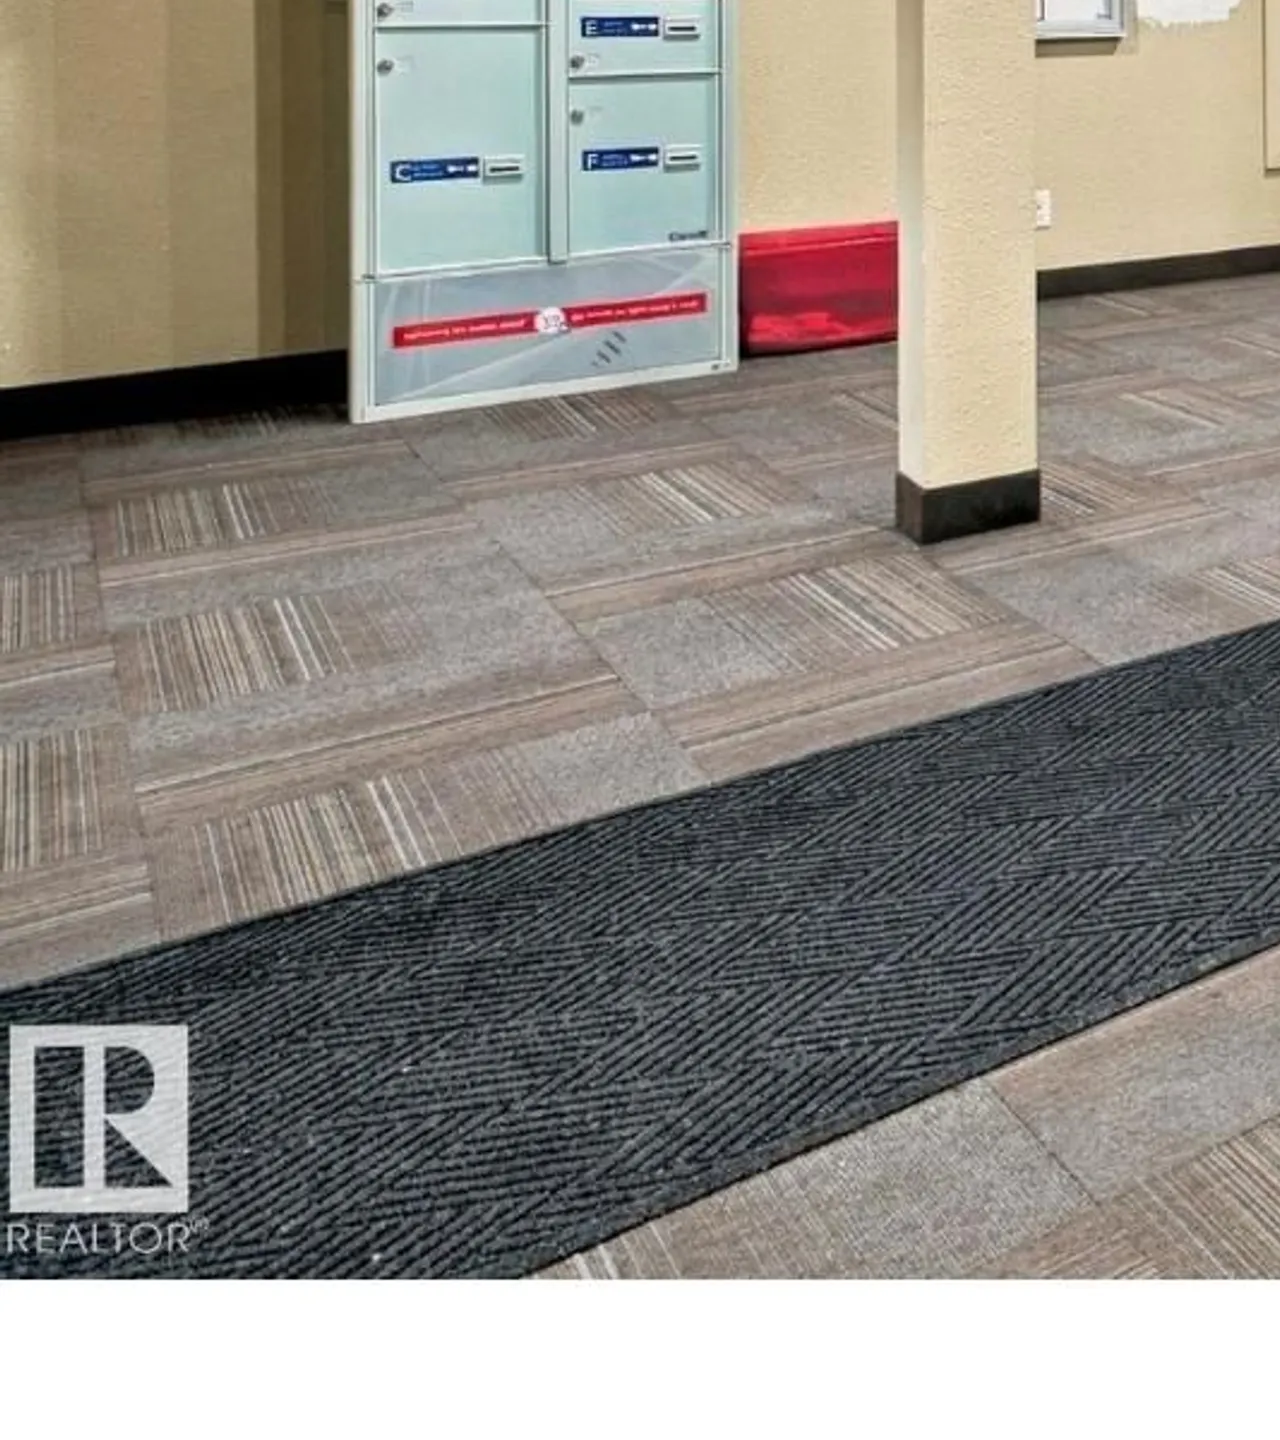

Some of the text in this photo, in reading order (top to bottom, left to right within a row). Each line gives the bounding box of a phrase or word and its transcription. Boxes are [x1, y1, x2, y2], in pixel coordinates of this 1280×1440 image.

[585, 20, 597, 36] E
[587, 153, 599, 170] F
[395, 163, 412, 181] C
